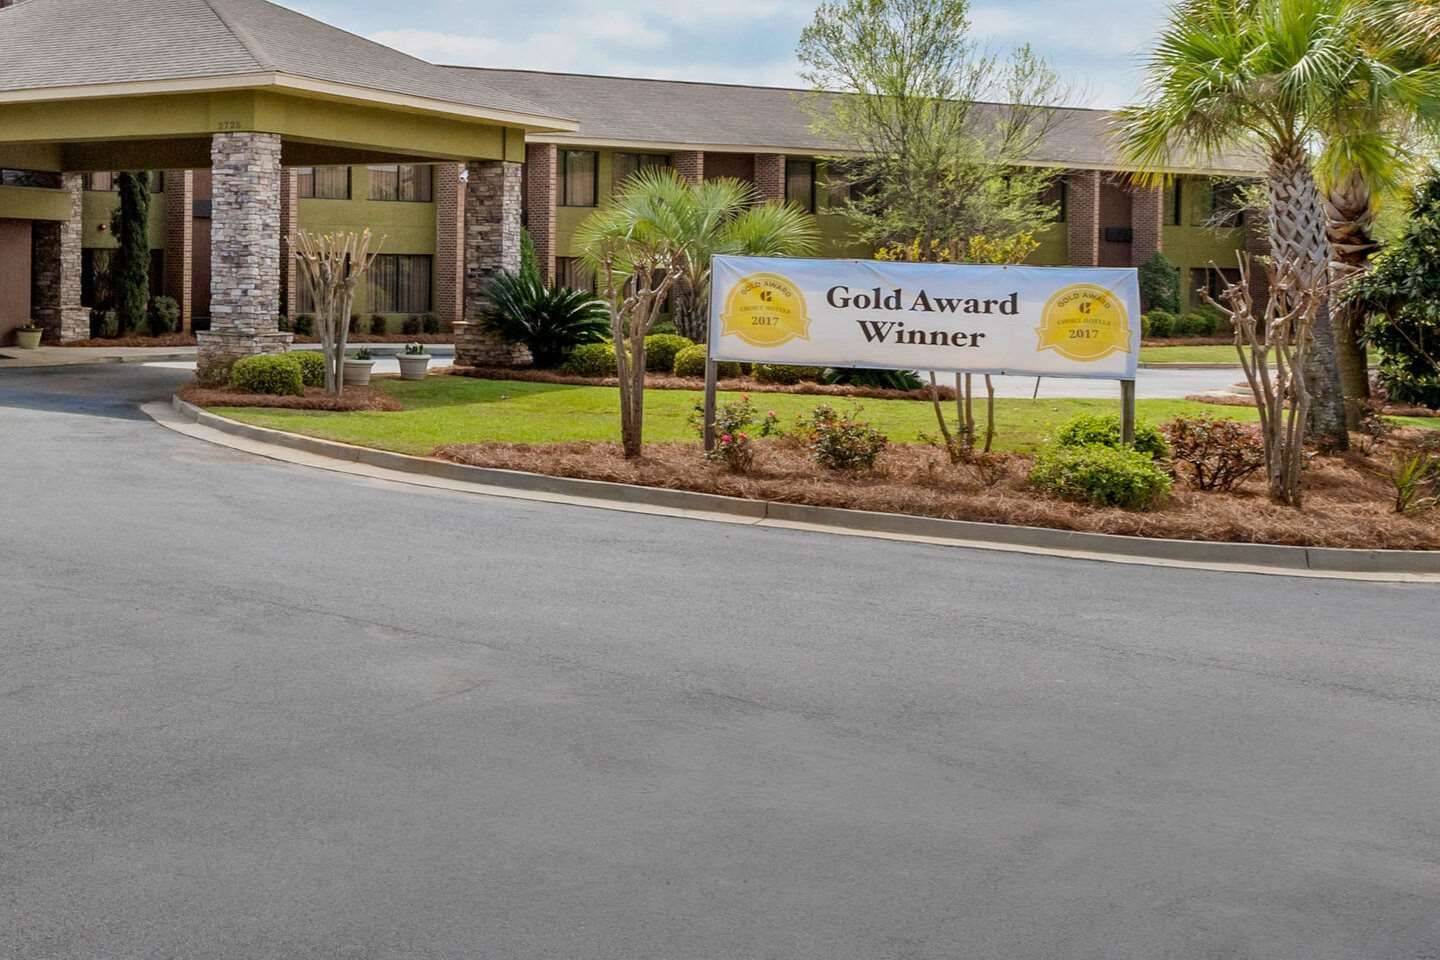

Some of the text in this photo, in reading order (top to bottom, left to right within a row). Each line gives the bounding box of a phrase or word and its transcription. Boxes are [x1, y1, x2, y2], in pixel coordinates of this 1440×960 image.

[763, 280, 792, 298] AWARD
[826, 285, 1019, 315] Gold Award
[1057, 292, 1080, 307] GOLD
[752, 316, 780, 326] 2017
[856, 319, 987, 348] Winner
[1068, 329, 1100, 339] 2017
